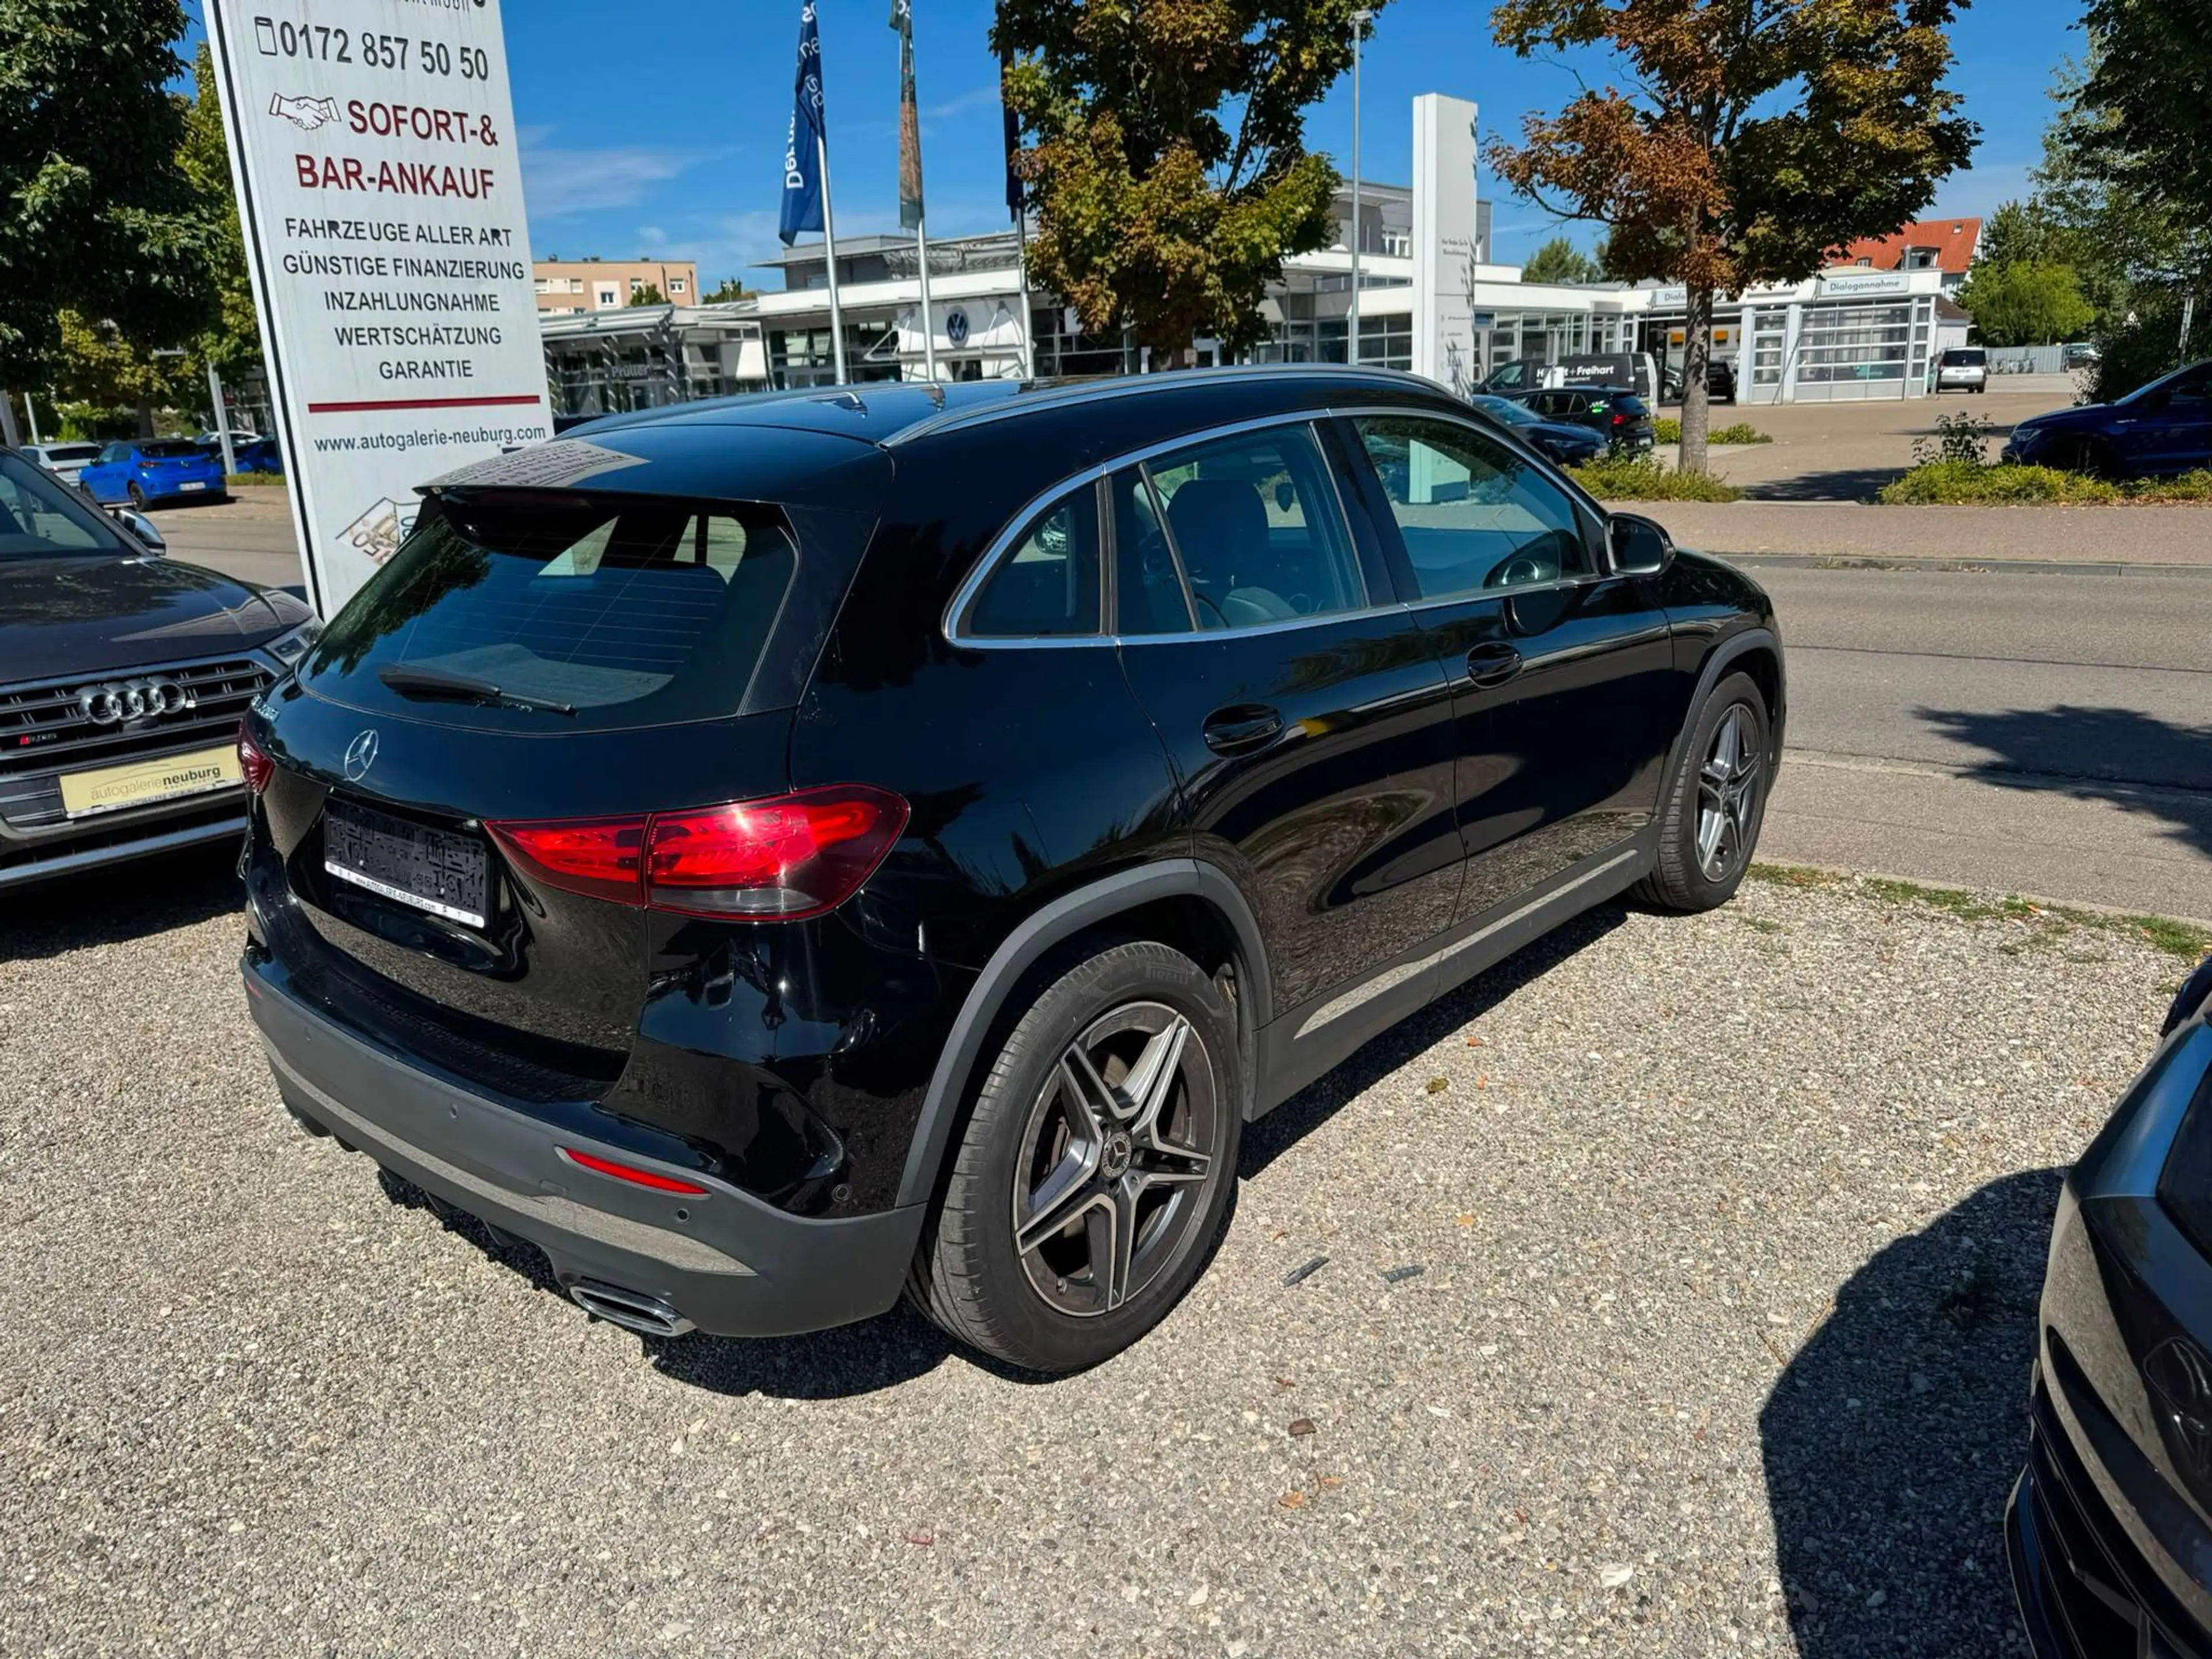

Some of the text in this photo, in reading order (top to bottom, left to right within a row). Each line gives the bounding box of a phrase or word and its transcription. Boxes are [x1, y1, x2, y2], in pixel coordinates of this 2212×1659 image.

[280, 21, 488, 81] 0172 857 50 50
[348, 100, 498, 146] SOFORT-&
[295, 154, 494, 199] BAR-ANKAUF
[285, 218, 512, 247] FAHRZEUGE ALLER ART
[283, 251, 524, 279] GÜNSTIGE FINANZIERUNG
[1830, 279, 1900, 291] Dialogannahme
[324, 291, 500, 311] INZAHLUNGNAHME
[334, 323, 501, 346] WERTSCHÄTZUNG
[379, 360, 474, 379] GARANTIE
[315, 427, 546, 452] www.autogalerie-neuburg.com
